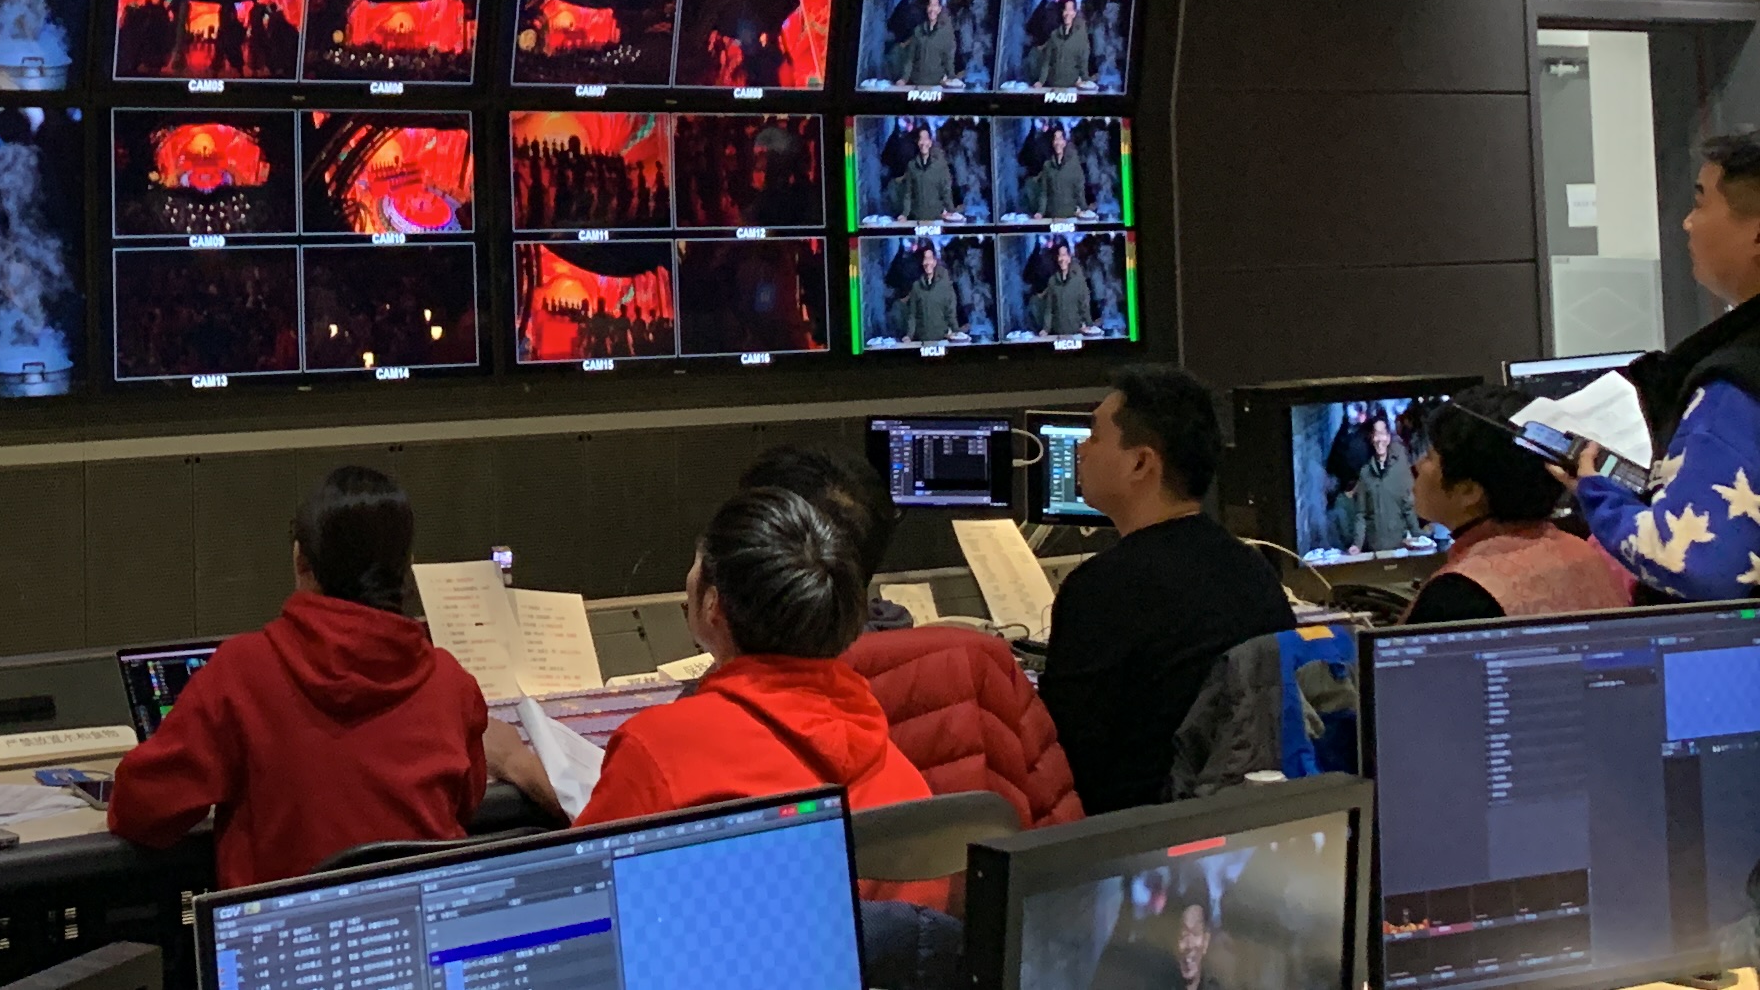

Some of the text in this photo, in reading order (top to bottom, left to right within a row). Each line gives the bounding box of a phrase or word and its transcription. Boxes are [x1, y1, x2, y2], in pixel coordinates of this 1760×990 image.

[188, 79, 224, 93] CAM05
[575, 84, 607, 98] CAM07
[371, 231, 405, 245] CAM10
[577, 229, 609, 242] CAM11
[736, 226, 766, 240] CAM12
[189, 233, 225, 248] CAM09
[582, 357, 613, 371] CAM15
[375, 365, 409, 380] CAM14
[192, 374, 228, 389] CAM13
